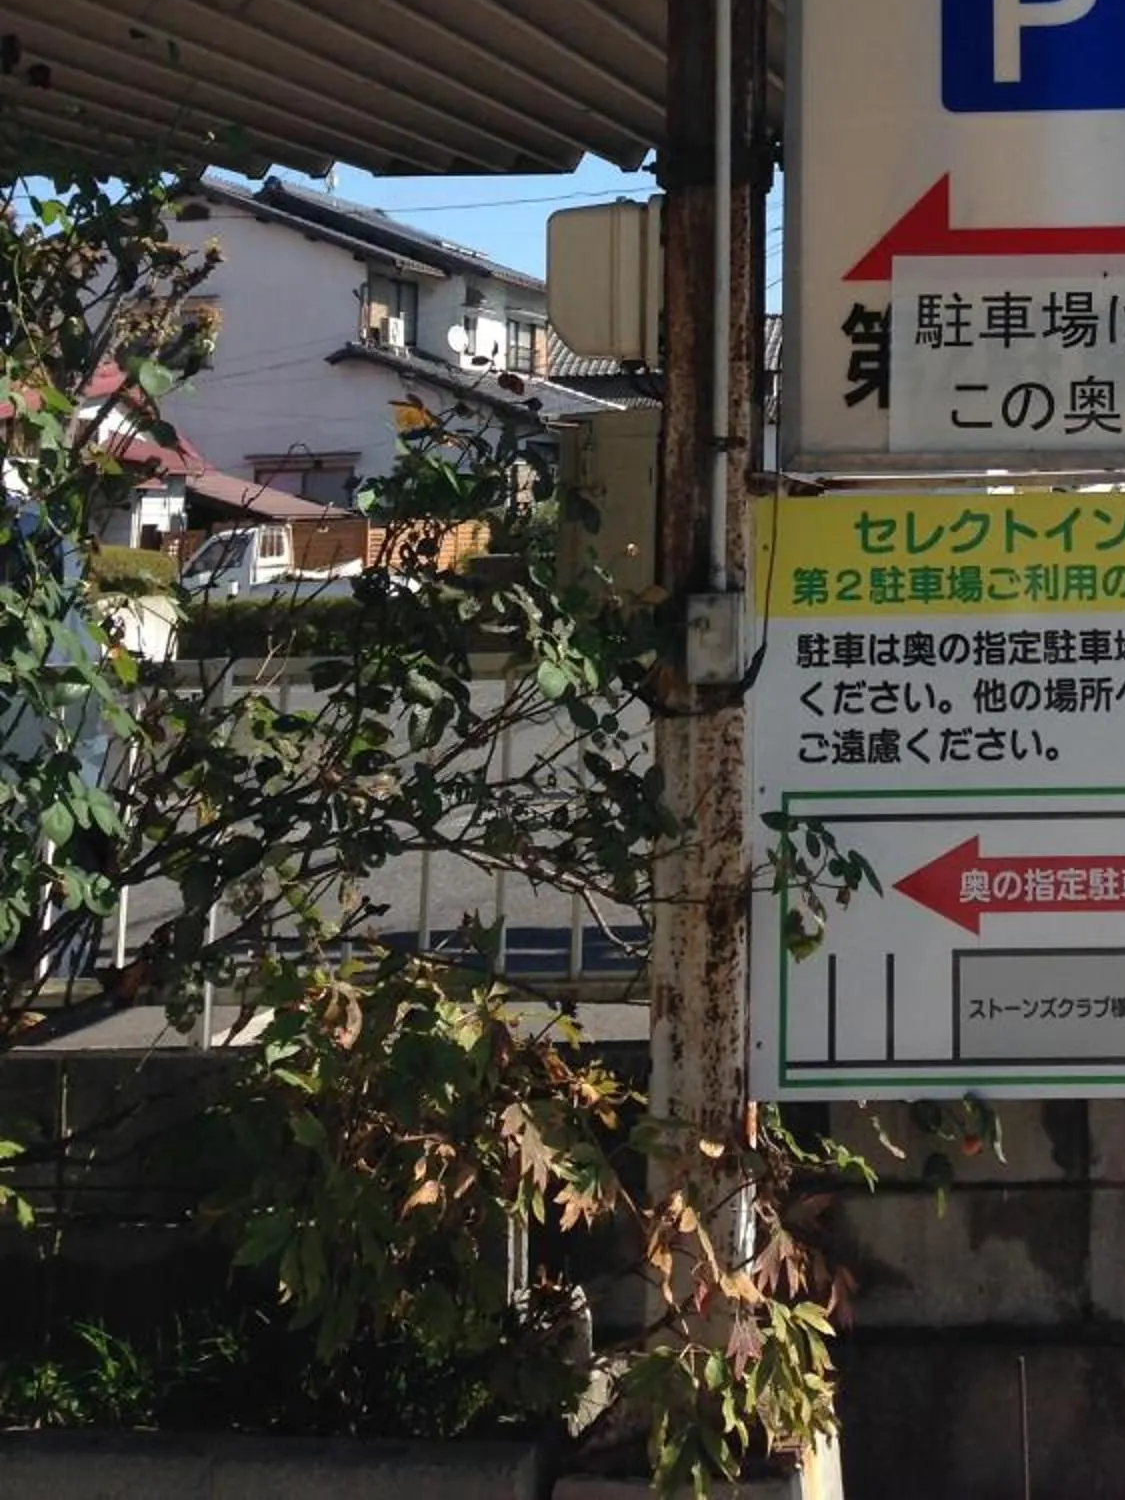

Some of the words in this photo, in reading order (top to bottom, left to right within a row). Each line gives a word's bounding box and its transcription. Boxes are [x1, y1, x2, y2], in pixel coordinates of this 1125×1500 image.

[950, 375, 1123, 435] この奥
[798, 728, 1061, 766] ご遠慮ください。
